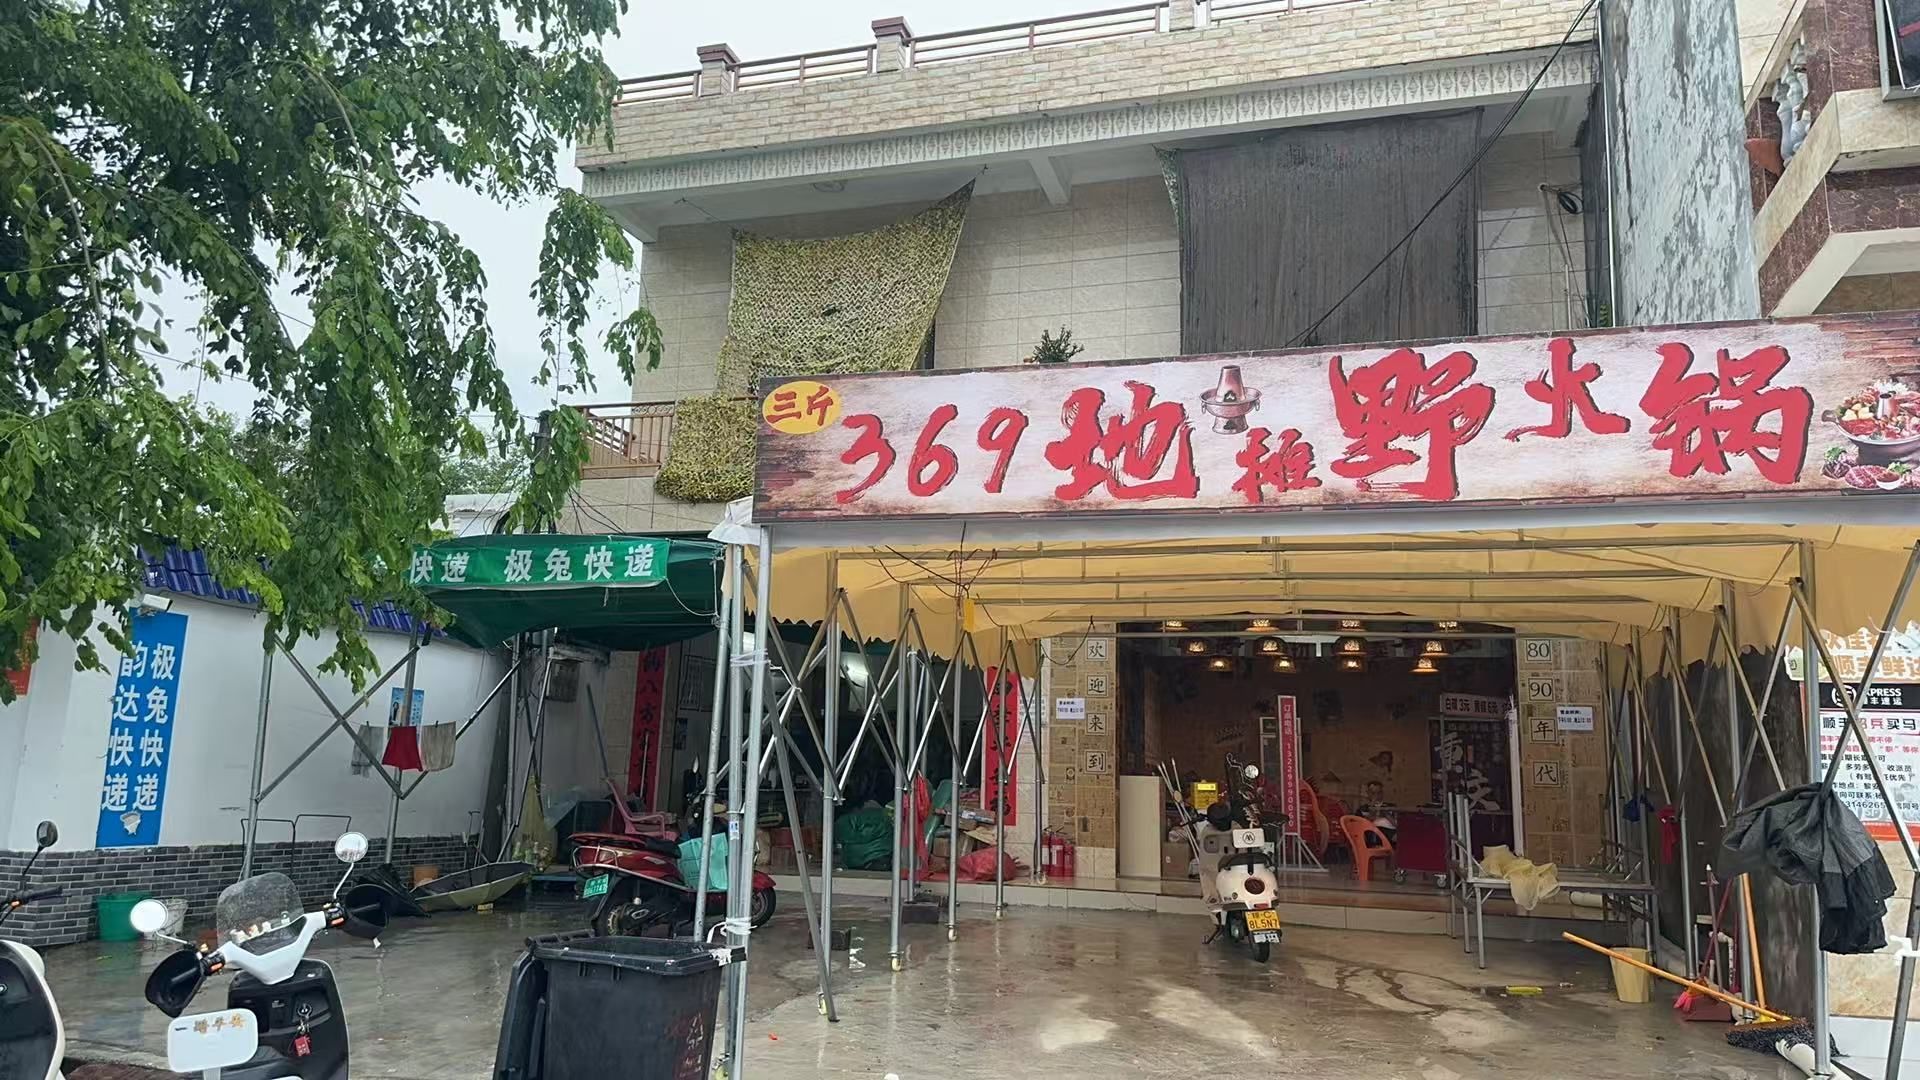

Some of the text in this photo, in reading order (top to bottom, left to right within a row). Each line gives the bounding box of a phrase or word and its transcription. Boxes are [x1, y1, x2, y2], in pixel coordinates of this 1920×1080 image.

[766, 385, 833, 426] 三斤
[504, 544, 656, 582] 极兔快递
[132, 643, 175, 811] 极兔快递
[1089, 642, 1105, 770] 欢迎来到
